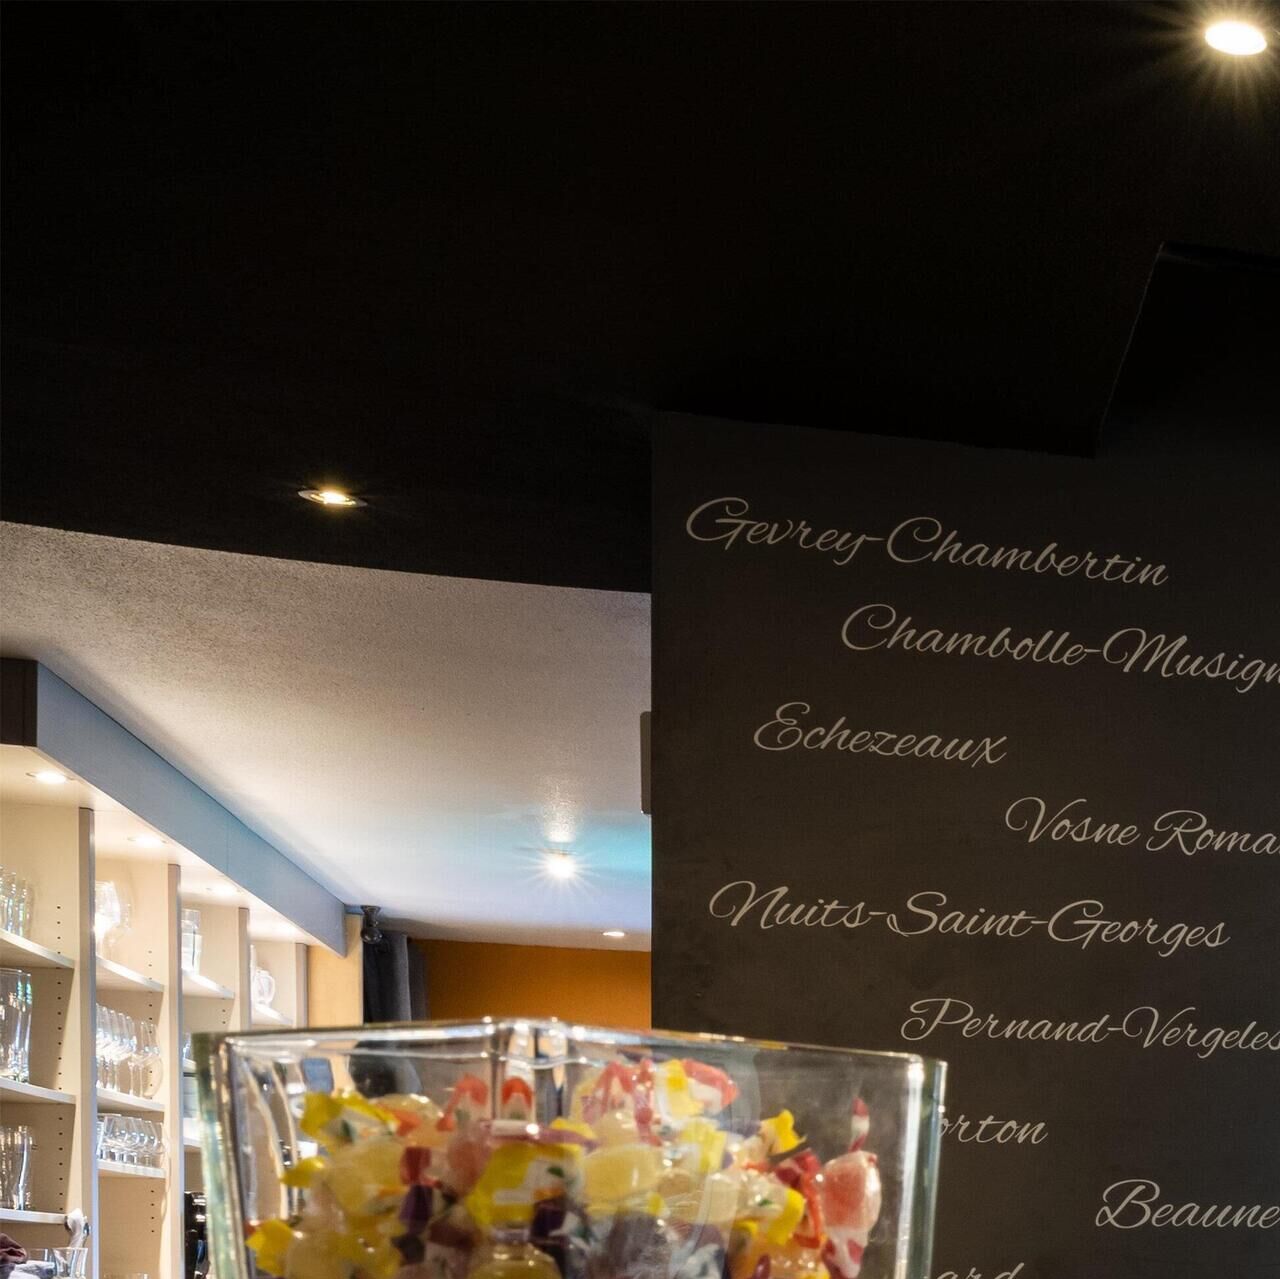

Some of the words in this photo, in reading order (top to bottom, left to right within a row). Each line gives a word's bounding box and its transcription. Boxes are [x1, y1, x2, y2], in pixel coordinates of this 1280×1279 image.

[685, 496, 1169, 586] Gevrey-Chambertin
[753, 701, 1008, 768] Echezeaux
[1004, 796, 1140, 848] Vosne
[708, 880, 1231, 958] Nuits-Saint-Georges
[939, 1113, 1049, 1145] orton
